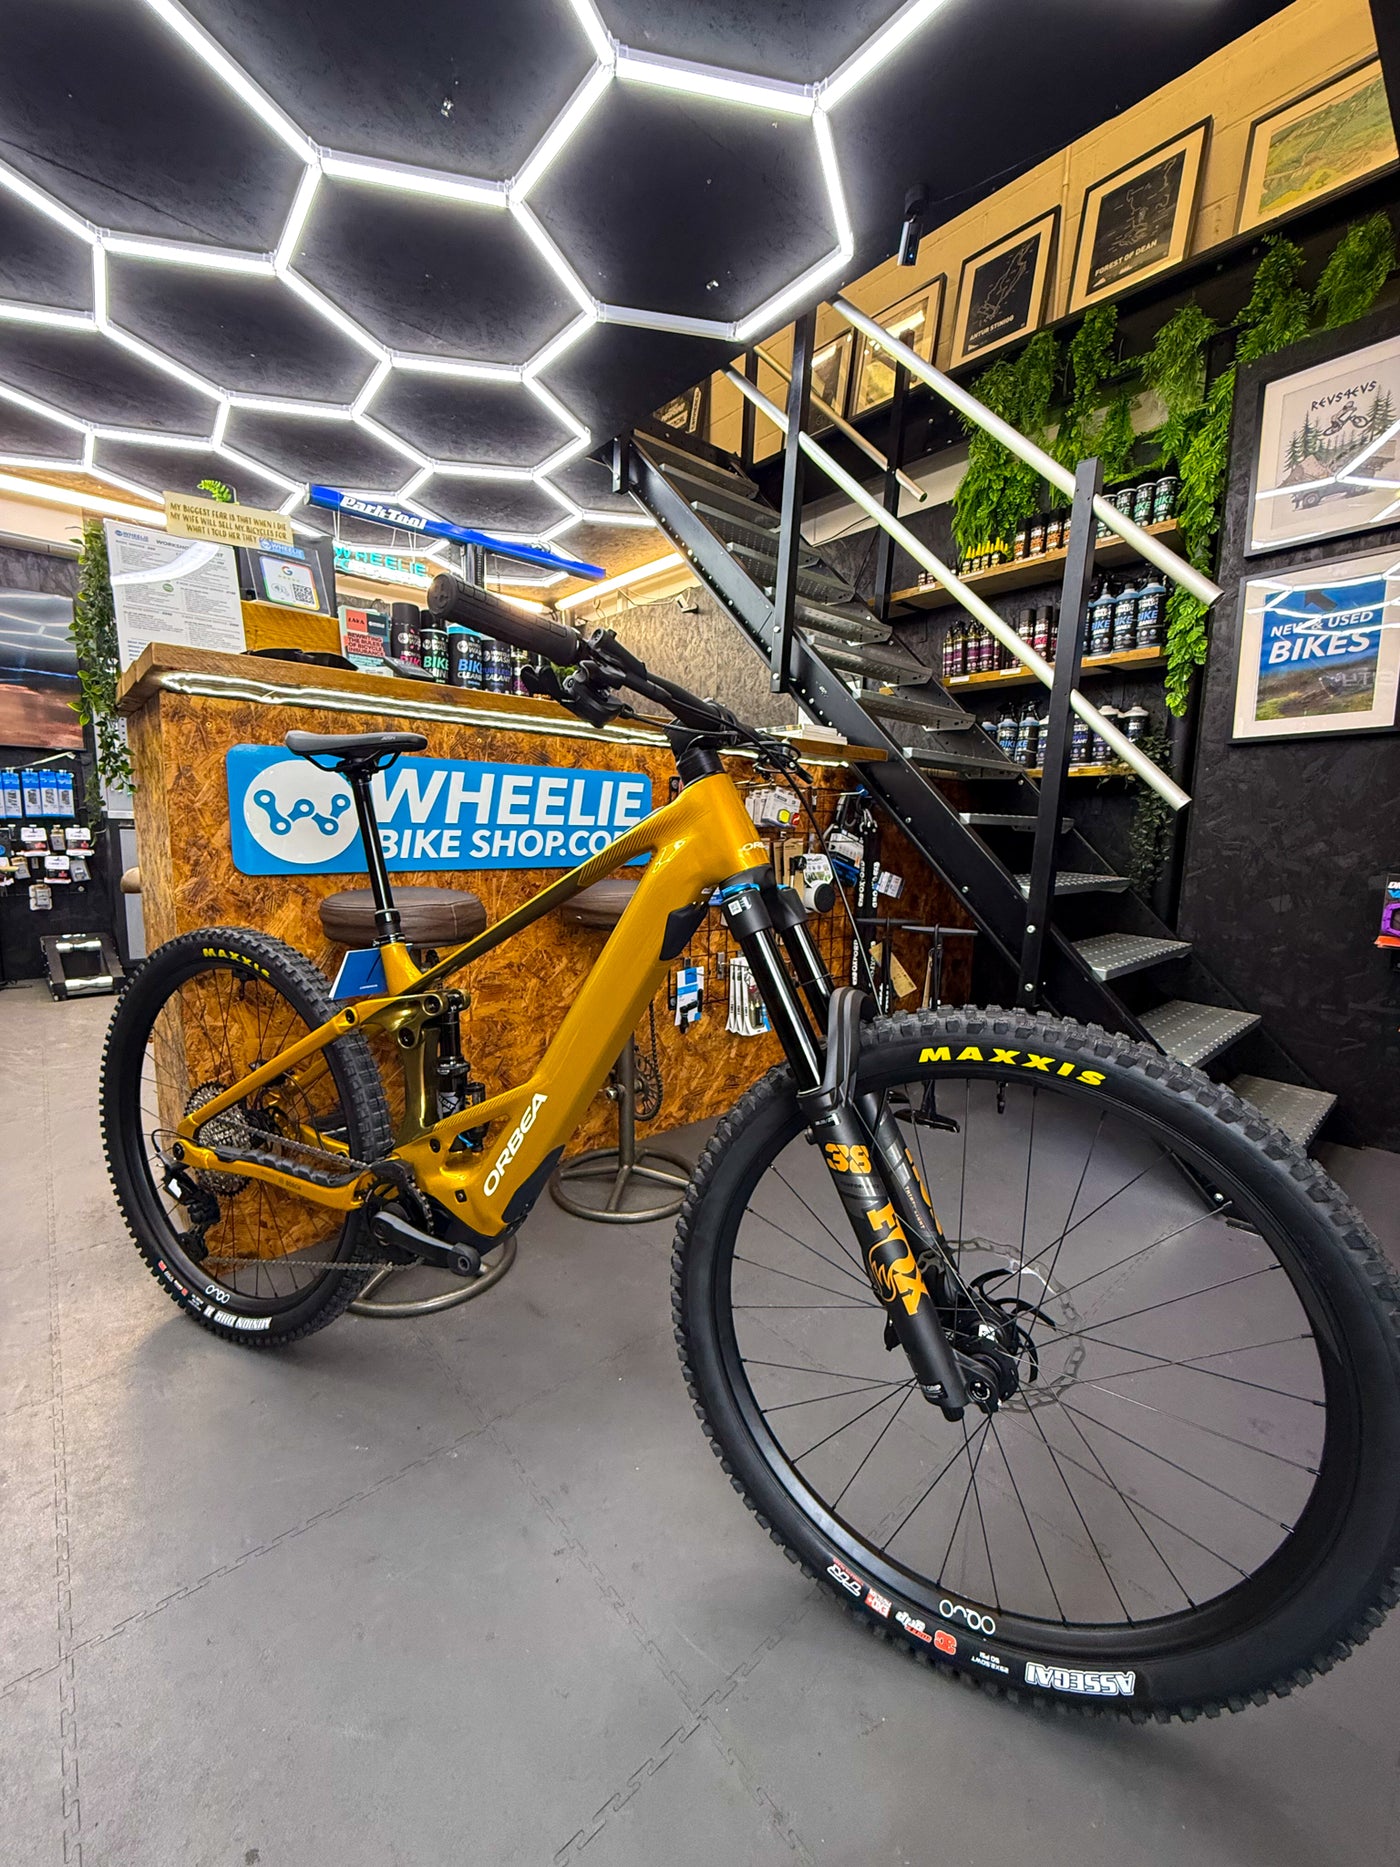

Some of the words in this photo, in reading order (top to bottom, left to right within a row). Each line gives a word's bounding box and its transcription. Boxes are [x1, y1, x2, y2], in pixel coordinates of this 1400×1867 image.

[1095, 256, 1123, 277] FOREST
[1124, 251, 1135, 262] OF
[1135, 239, 1158, 255] DEAN
[170, 502, 181, 511] MY
[183, 504, 210, 516] BIGGEST
[211, 509, 227, 518] FEAR
[229, 513, 235, 521] IS
[236, 514, 252, 524] THAT
[253, 518, 272, 528] WHEN
[277, 522, 287, 531] DIE
[170, 511, 181, 520] MY
[182, 513, 199, 524] WIFE
[200, 517, 217, 528] WILL
[218, 521, 233, 530] SELL
[246, 526, 274, 537] BICYCLES
[275, 530, 287, 540] FOR
[186, 524, 206, 534] WHAT
[211, 528, 227, 538] TOLD
[228, 531, 241, 540] HER
[242, 533, 257, 543] THEY
[333, 547, 427, 577] WHEELIE
[1328, 611, 1374, 628] USED
[423, 655, 449, 670] BIKE
[1268, 632, 1371, 664] BIKES
[458, 659, 482, 674] BIK
[371, 767, 645, 827] WHEELIE
[382, 828, 461, 860] BIKE
[202, 948, 270, 978] MAXXIS
[918, 1046, 1106, 1086] MAXXIS
[483, 1093, 548, 1197] ORBEA
[825, 1143, 872, 1174] 38
[866, 1200, 929, 1316] FOX
[235, 1317, 272, 1330] MINION
[1025, 1661, 1136, 1696] ASSEGAI
